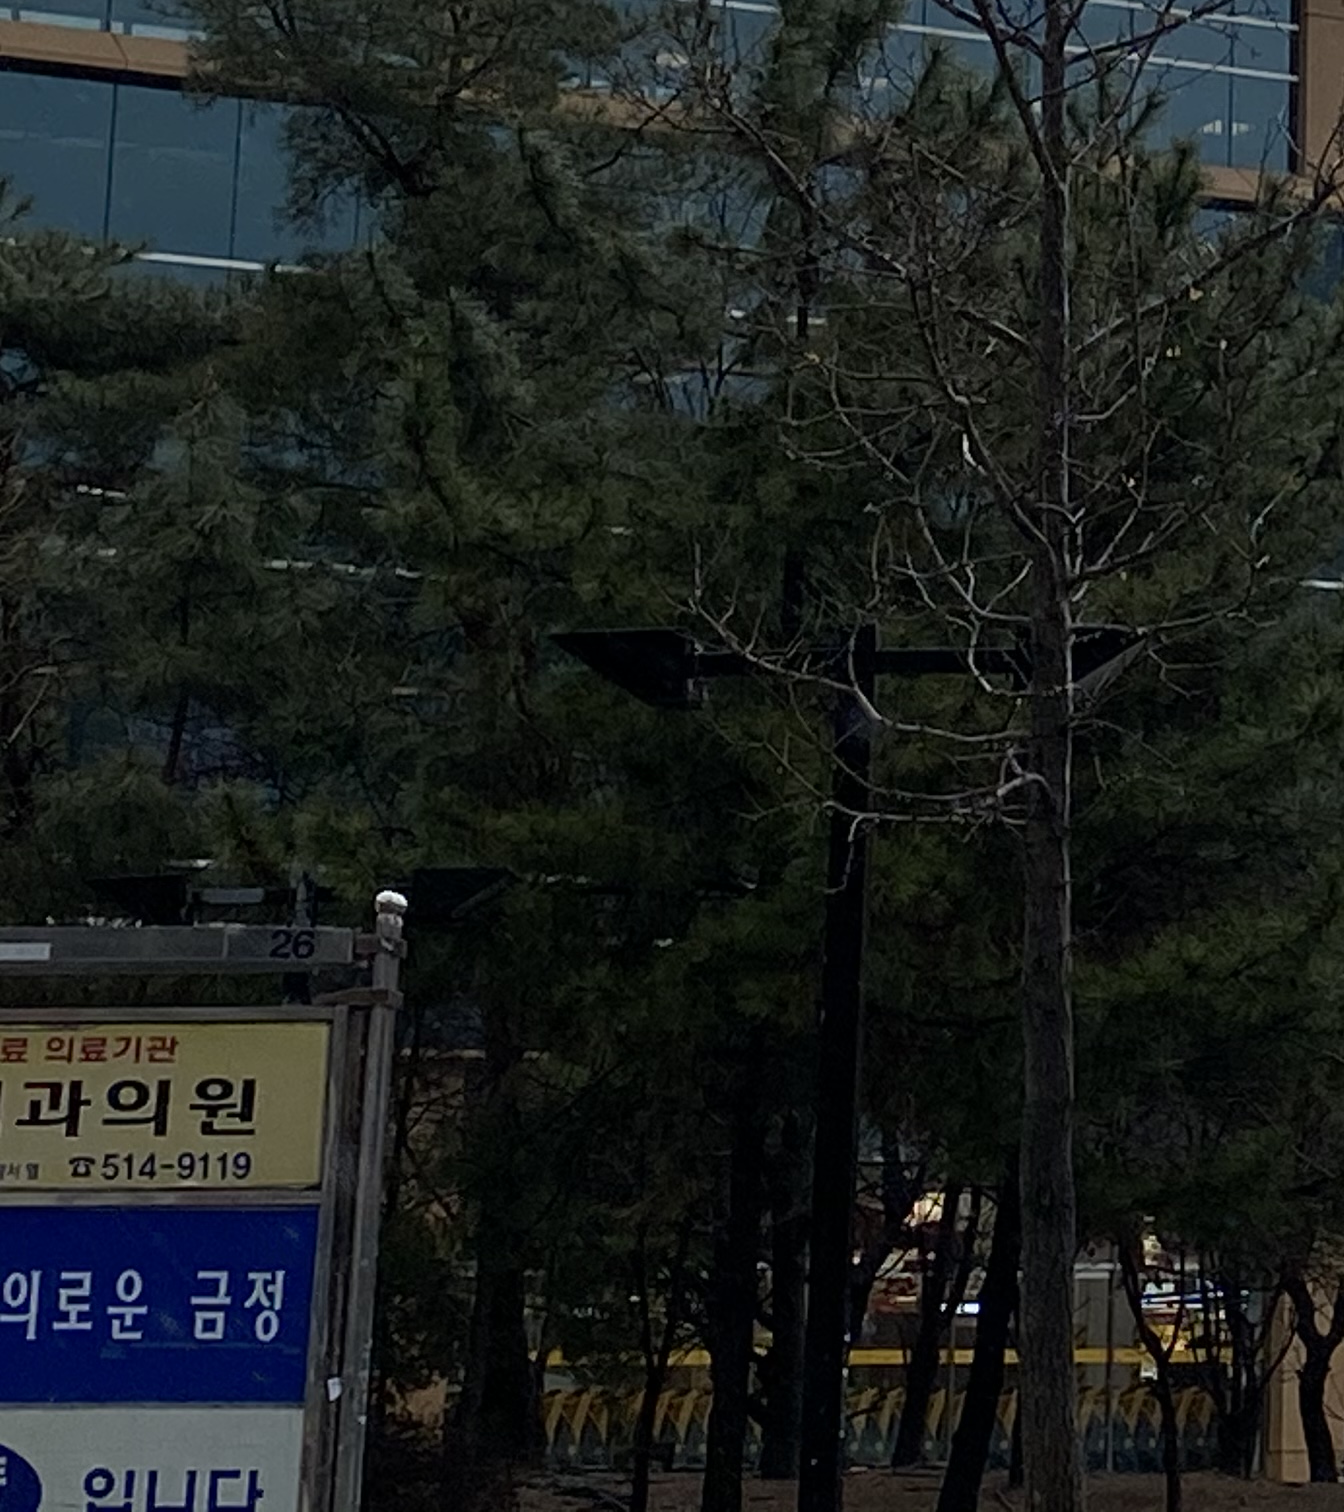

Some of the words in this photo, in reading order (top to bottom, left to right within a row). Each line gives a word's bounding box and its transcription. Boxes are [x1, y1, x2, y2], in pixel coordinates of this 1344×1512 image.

[270, 929, 315, 959] 26
[0, 1036, 28, 1063] 료
[44, 1036, 179, 1064] 의료기관
[0, 1078, 256, 1137] 과의원
[101, 1152, 252, 1181] 514-9119
[0, 1268, 148, 1342] 의로운
[190, 1268, 287, 1343] 금정
